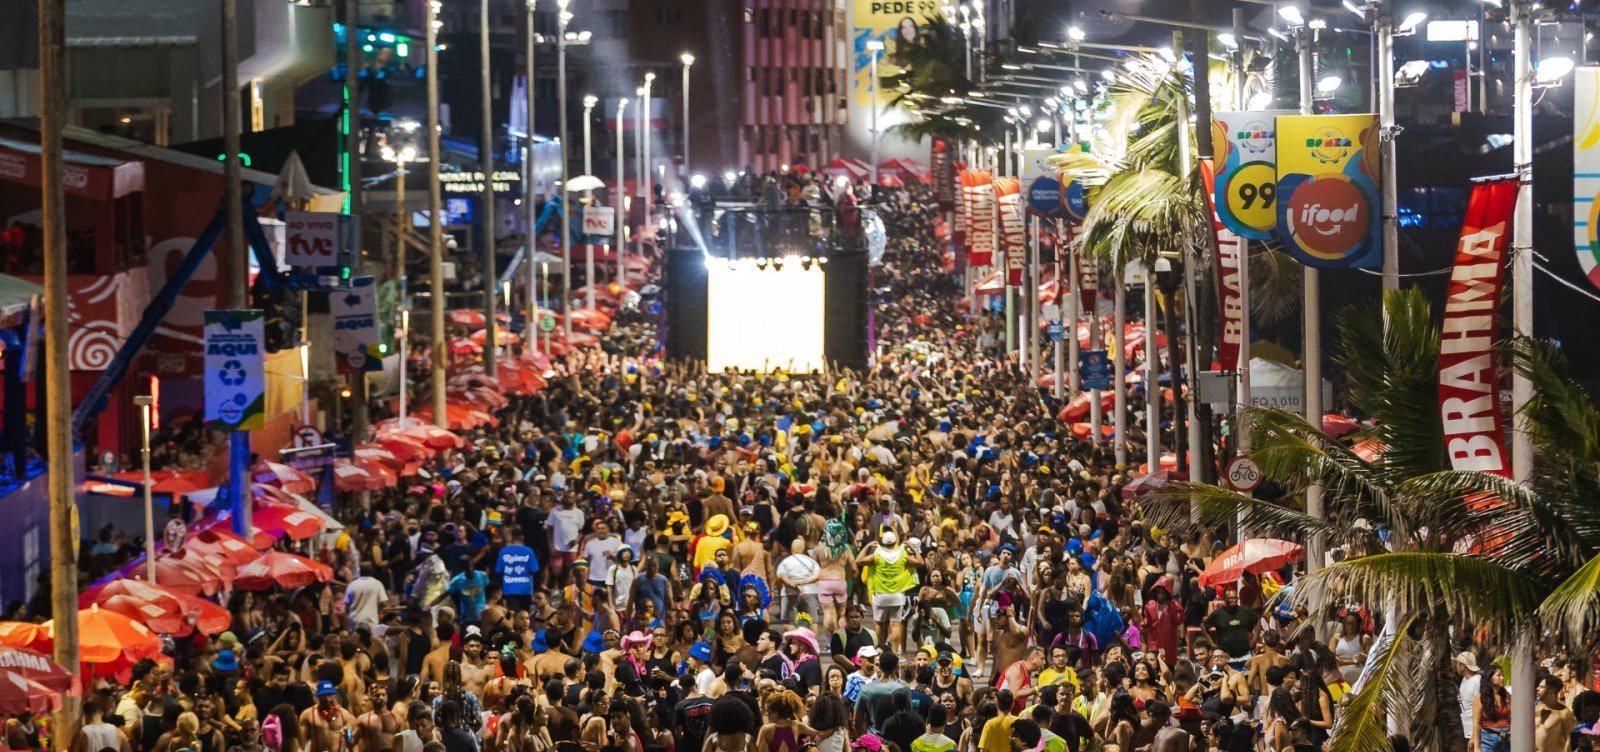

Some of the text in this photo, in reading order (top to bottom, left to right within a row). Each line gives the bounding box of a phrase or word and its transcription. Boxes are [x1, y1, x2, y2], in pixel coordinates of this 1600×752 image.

[871, 2, 913, 15] PEDE
[1238, 182, 1277, 210] 99
[308, 221, 334, 230] VIVO
[971, 184, 992, 253] BRAHMA
[1300, 202, 1358, 227] ifood
[288, 233, 334, 257] tve
[206, 343, 259, 357] AQUI
[1438, 220, 1506, 472] BRAHMA
